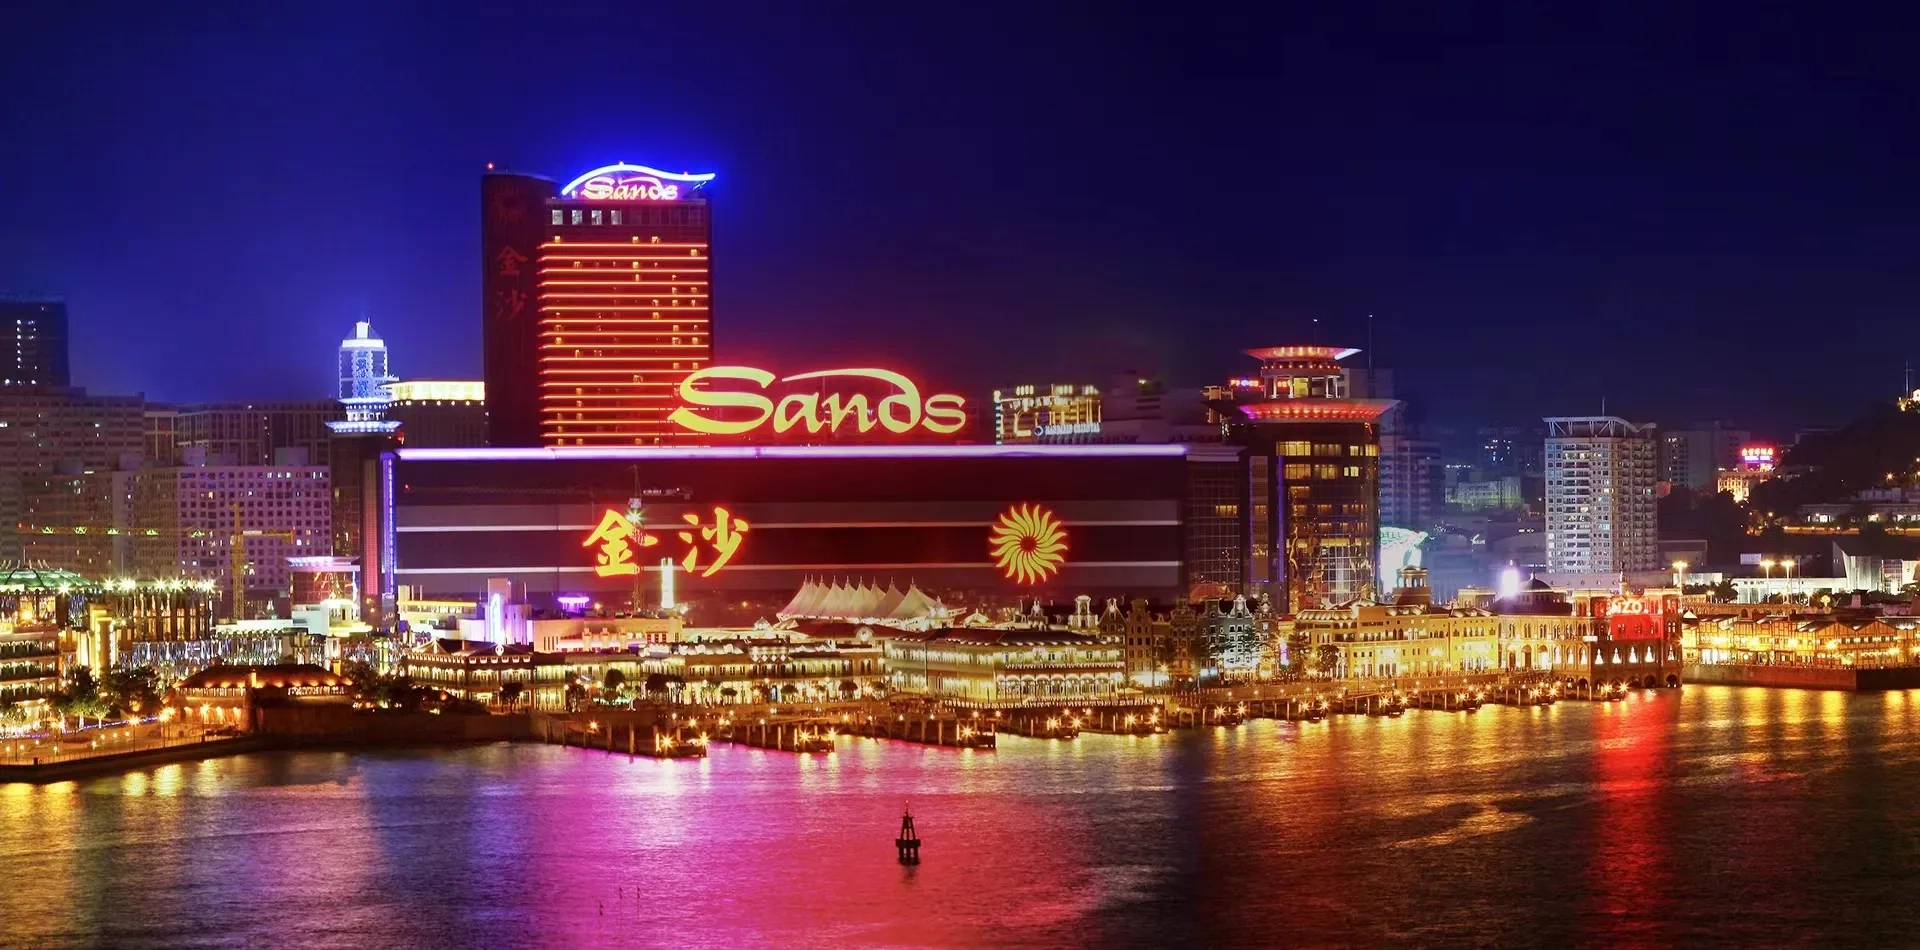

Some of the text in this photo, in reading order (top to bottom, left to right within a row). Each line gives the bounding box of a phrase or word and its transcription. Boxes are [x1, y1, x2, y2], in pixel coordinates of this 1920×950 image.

[581, 177, 678, 200] Sands
[496, 245, 529, 320] 金沙
[667, 366, 966, 434] Sands
[582, 507, 750, 577] 金沙
